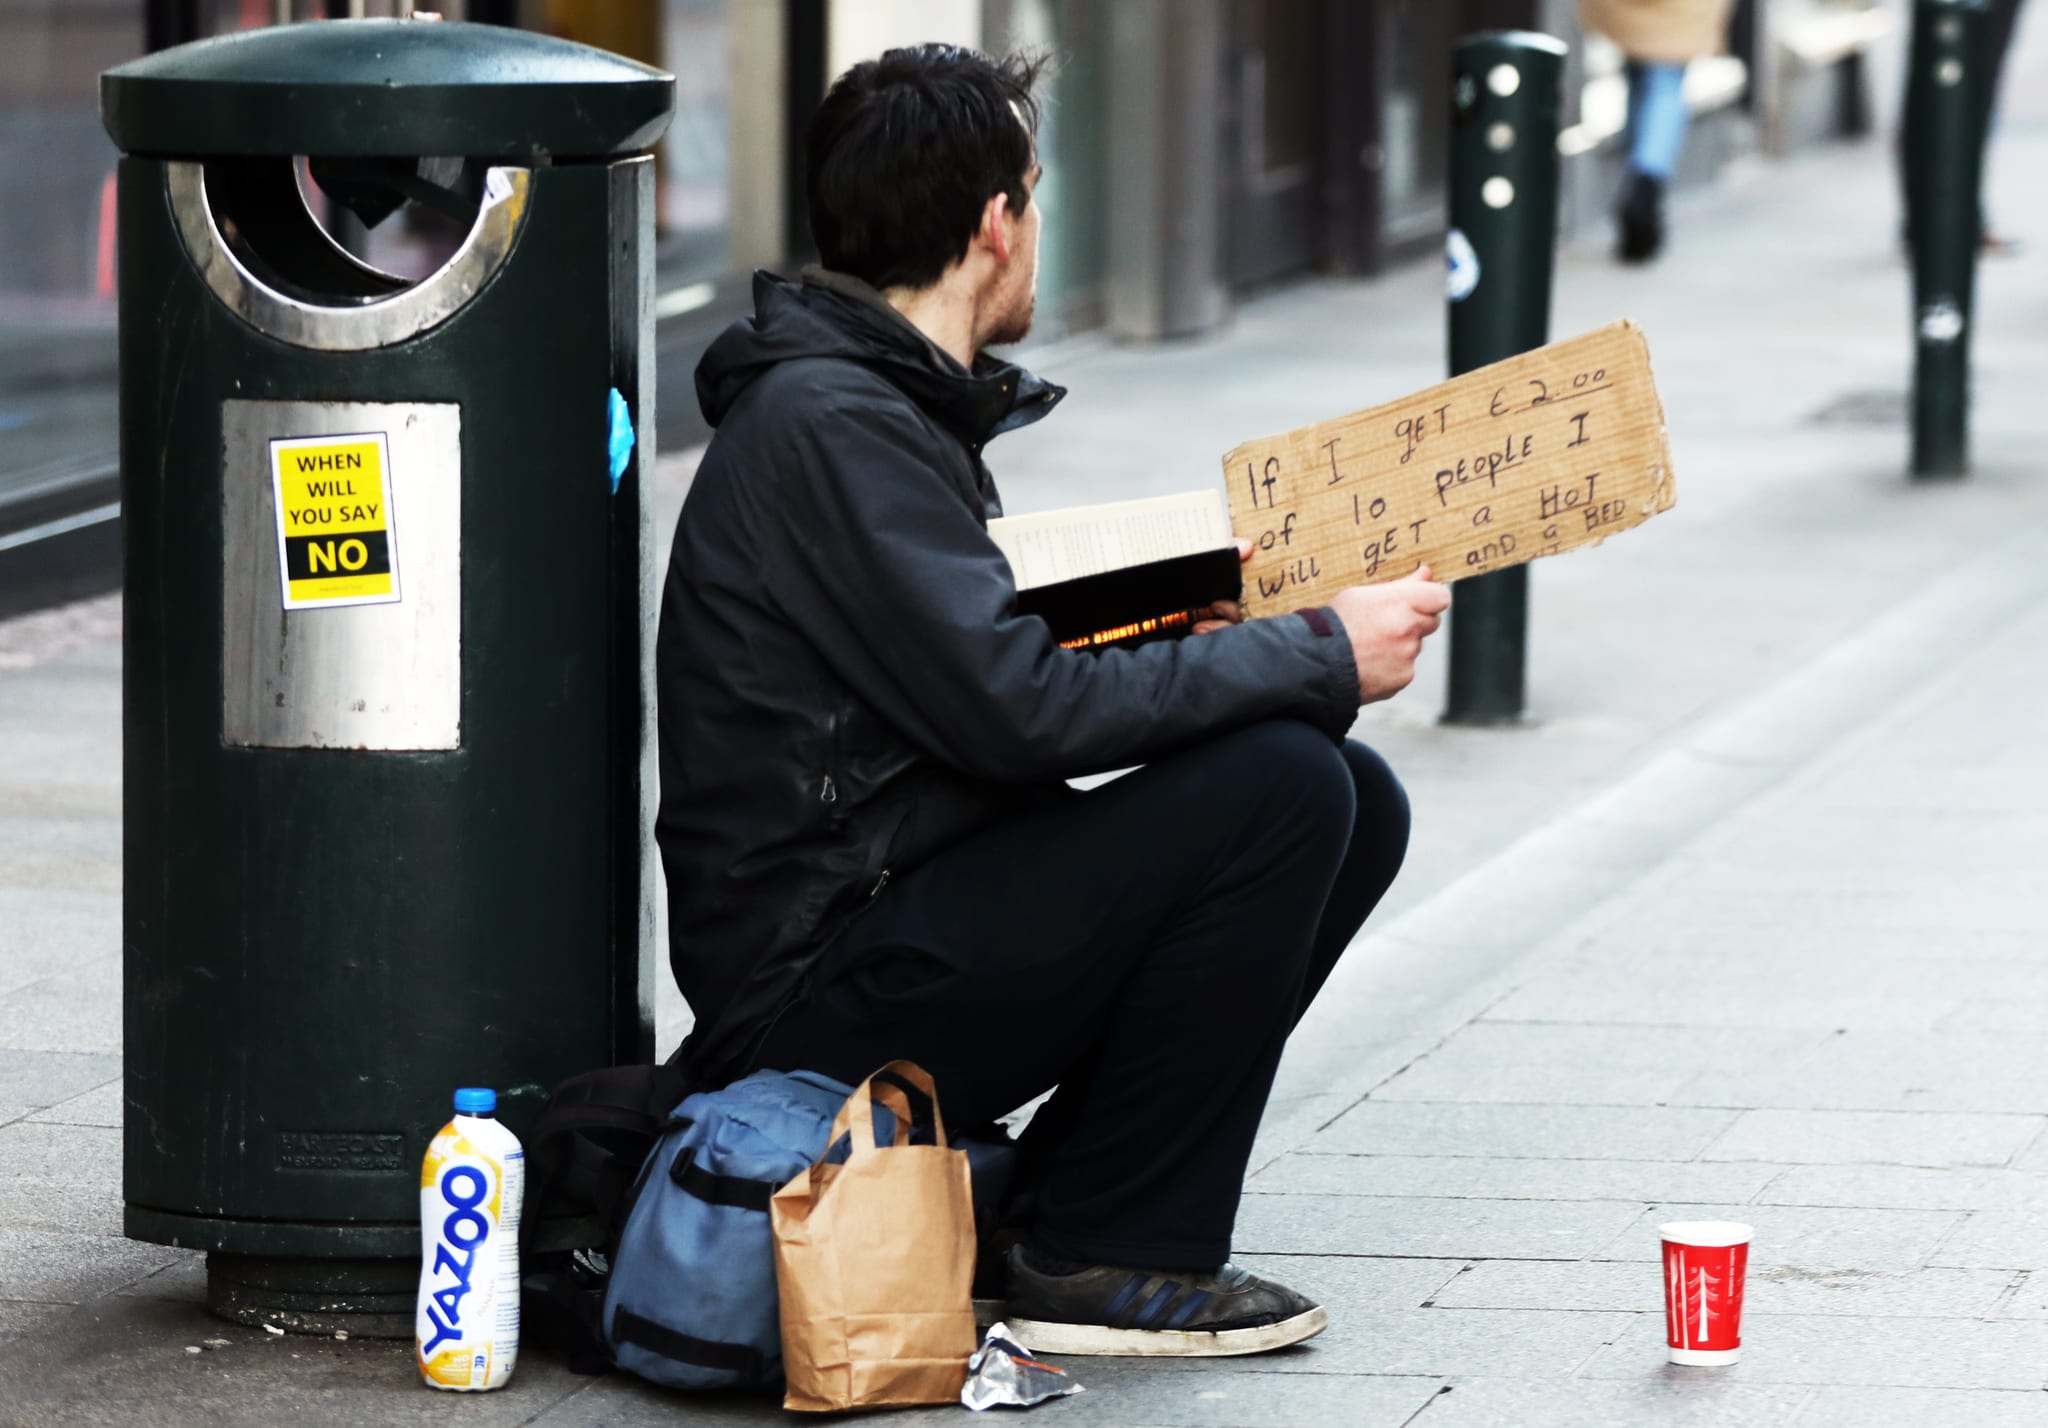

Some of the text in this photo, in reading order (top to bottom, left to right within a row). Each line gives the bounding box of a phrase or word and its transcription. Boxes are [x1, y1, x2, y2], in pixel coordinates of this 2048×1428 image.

[297, 453, 362, 472] WHEN
[1322, 437, 1345, 486] I
[307, 480, 357, 498] WILL
[1259, 512, 1297, 551] of
[1566, 411, 1591, 449] I
[290, 504, 379, 525] YOU SAY
[1473, 505, 1493, 527] a
[1583, 499, 1626, 533] BED
[307, 539, 369, 574] NO
[423, 1164, 489, 1356] YAZOO
